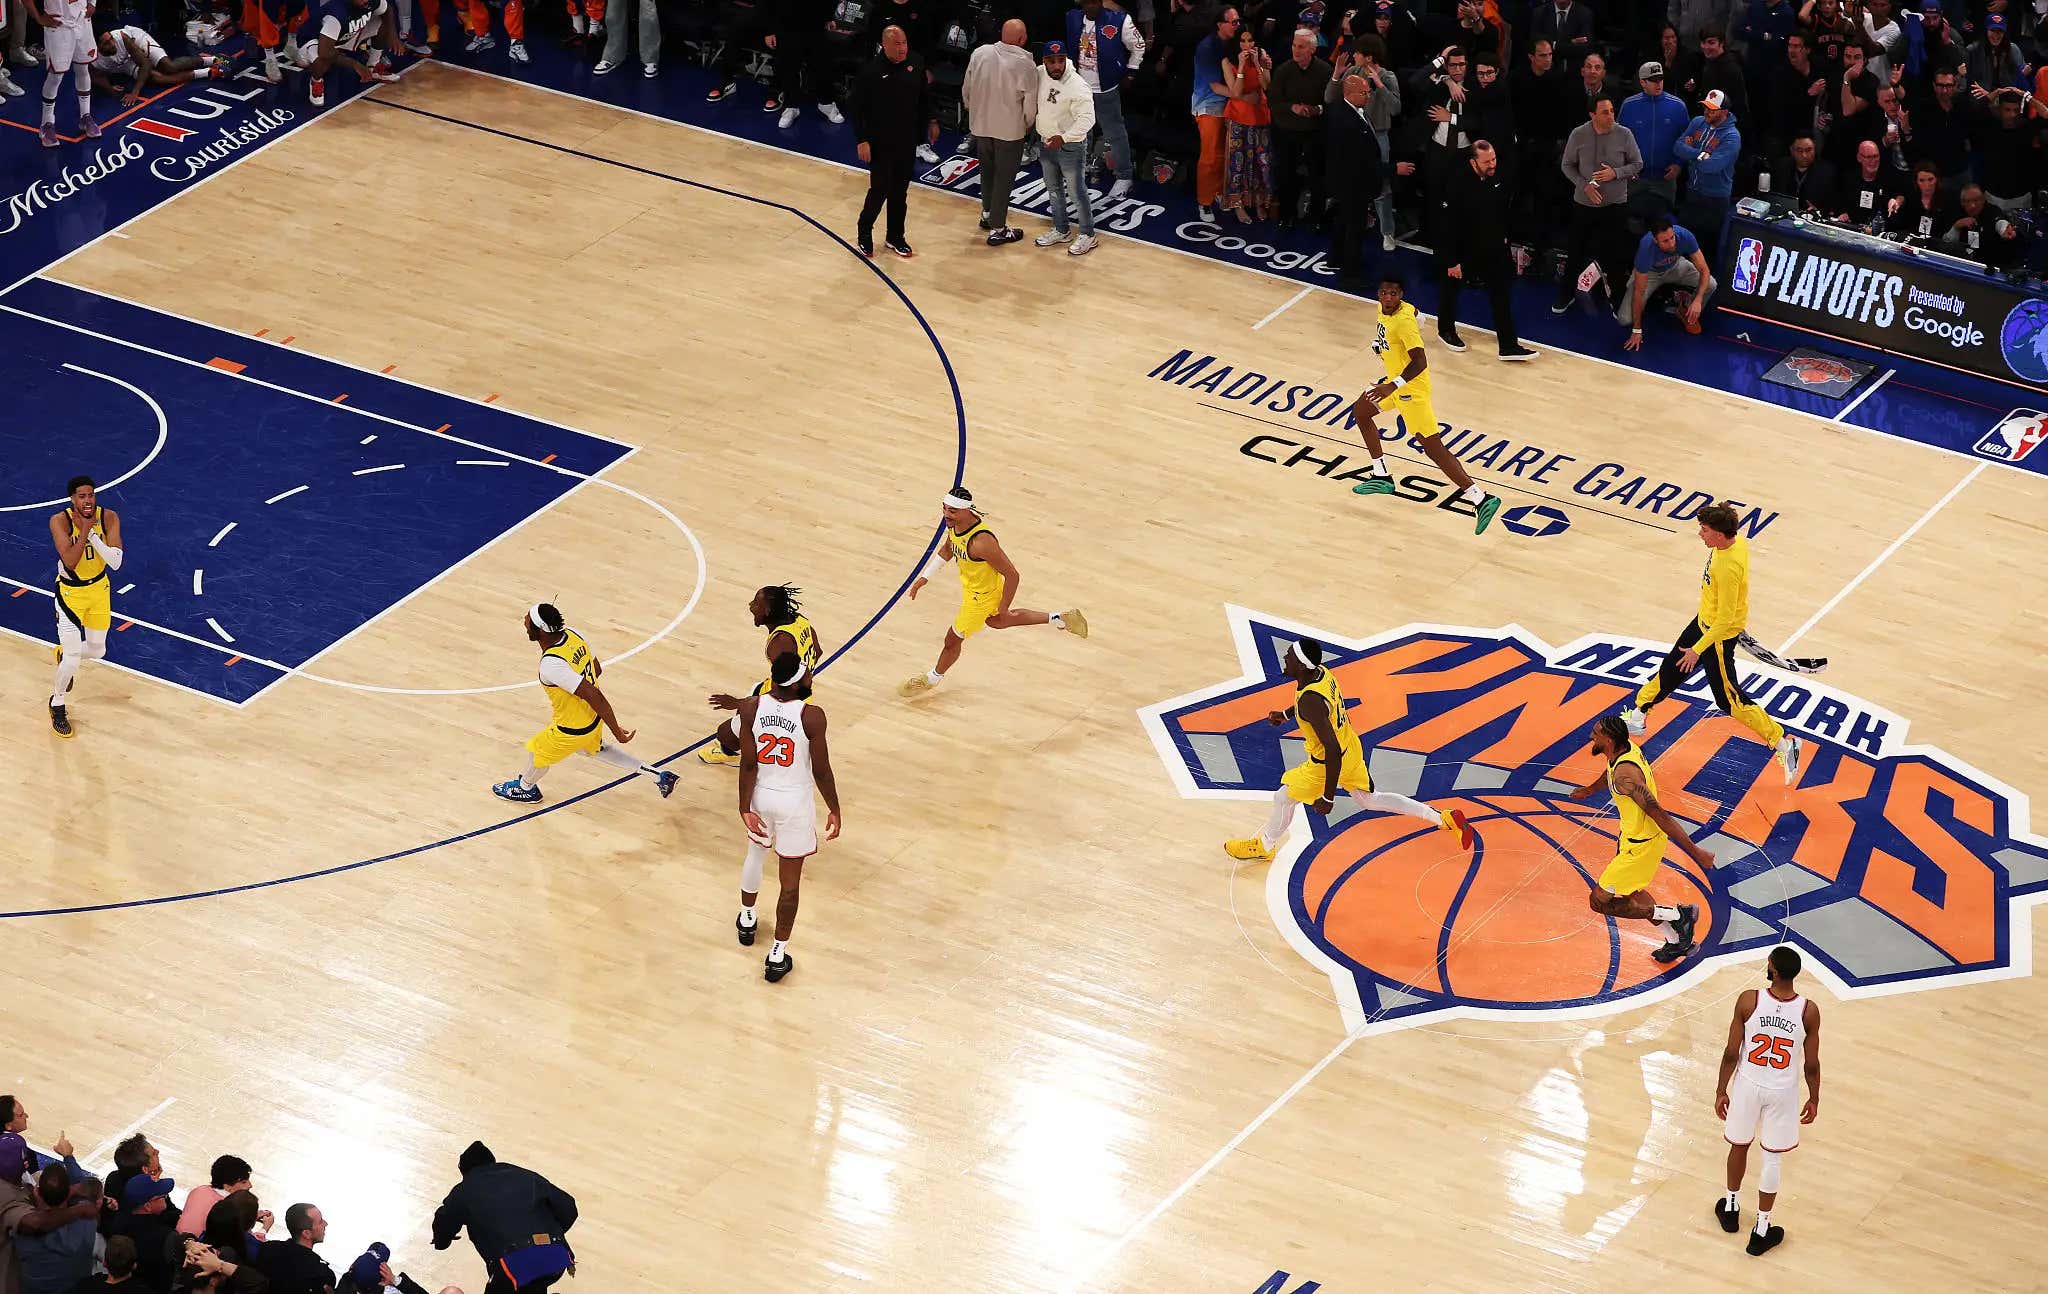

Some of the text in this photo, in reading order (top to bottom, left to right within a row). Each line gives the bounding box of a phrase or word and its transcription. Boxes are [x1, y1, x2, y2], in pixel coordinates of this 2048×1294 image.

[1046, 88, 1061, 104] K
[150, 105, 294, 182] Courtside
[0, 134, 145, 234] Michelob
[1758, 246, 1904, 328] PLAYOFFS
[1908, 285, 1966, 317] Presented by
[1904, 306, 1985, 347] Google
[1980, 442, 2008, 456] NBA
[1573, 462, 1780, 539] GARDN
[85, 545, 95, 560] 0
[760, 715, 797, 734] ROBINSON
[757, 732, 795, 768] 23
[1760, 1016, 1797, 1034] BRIDGES
[1748, 1033, 1795, 1070] 25
